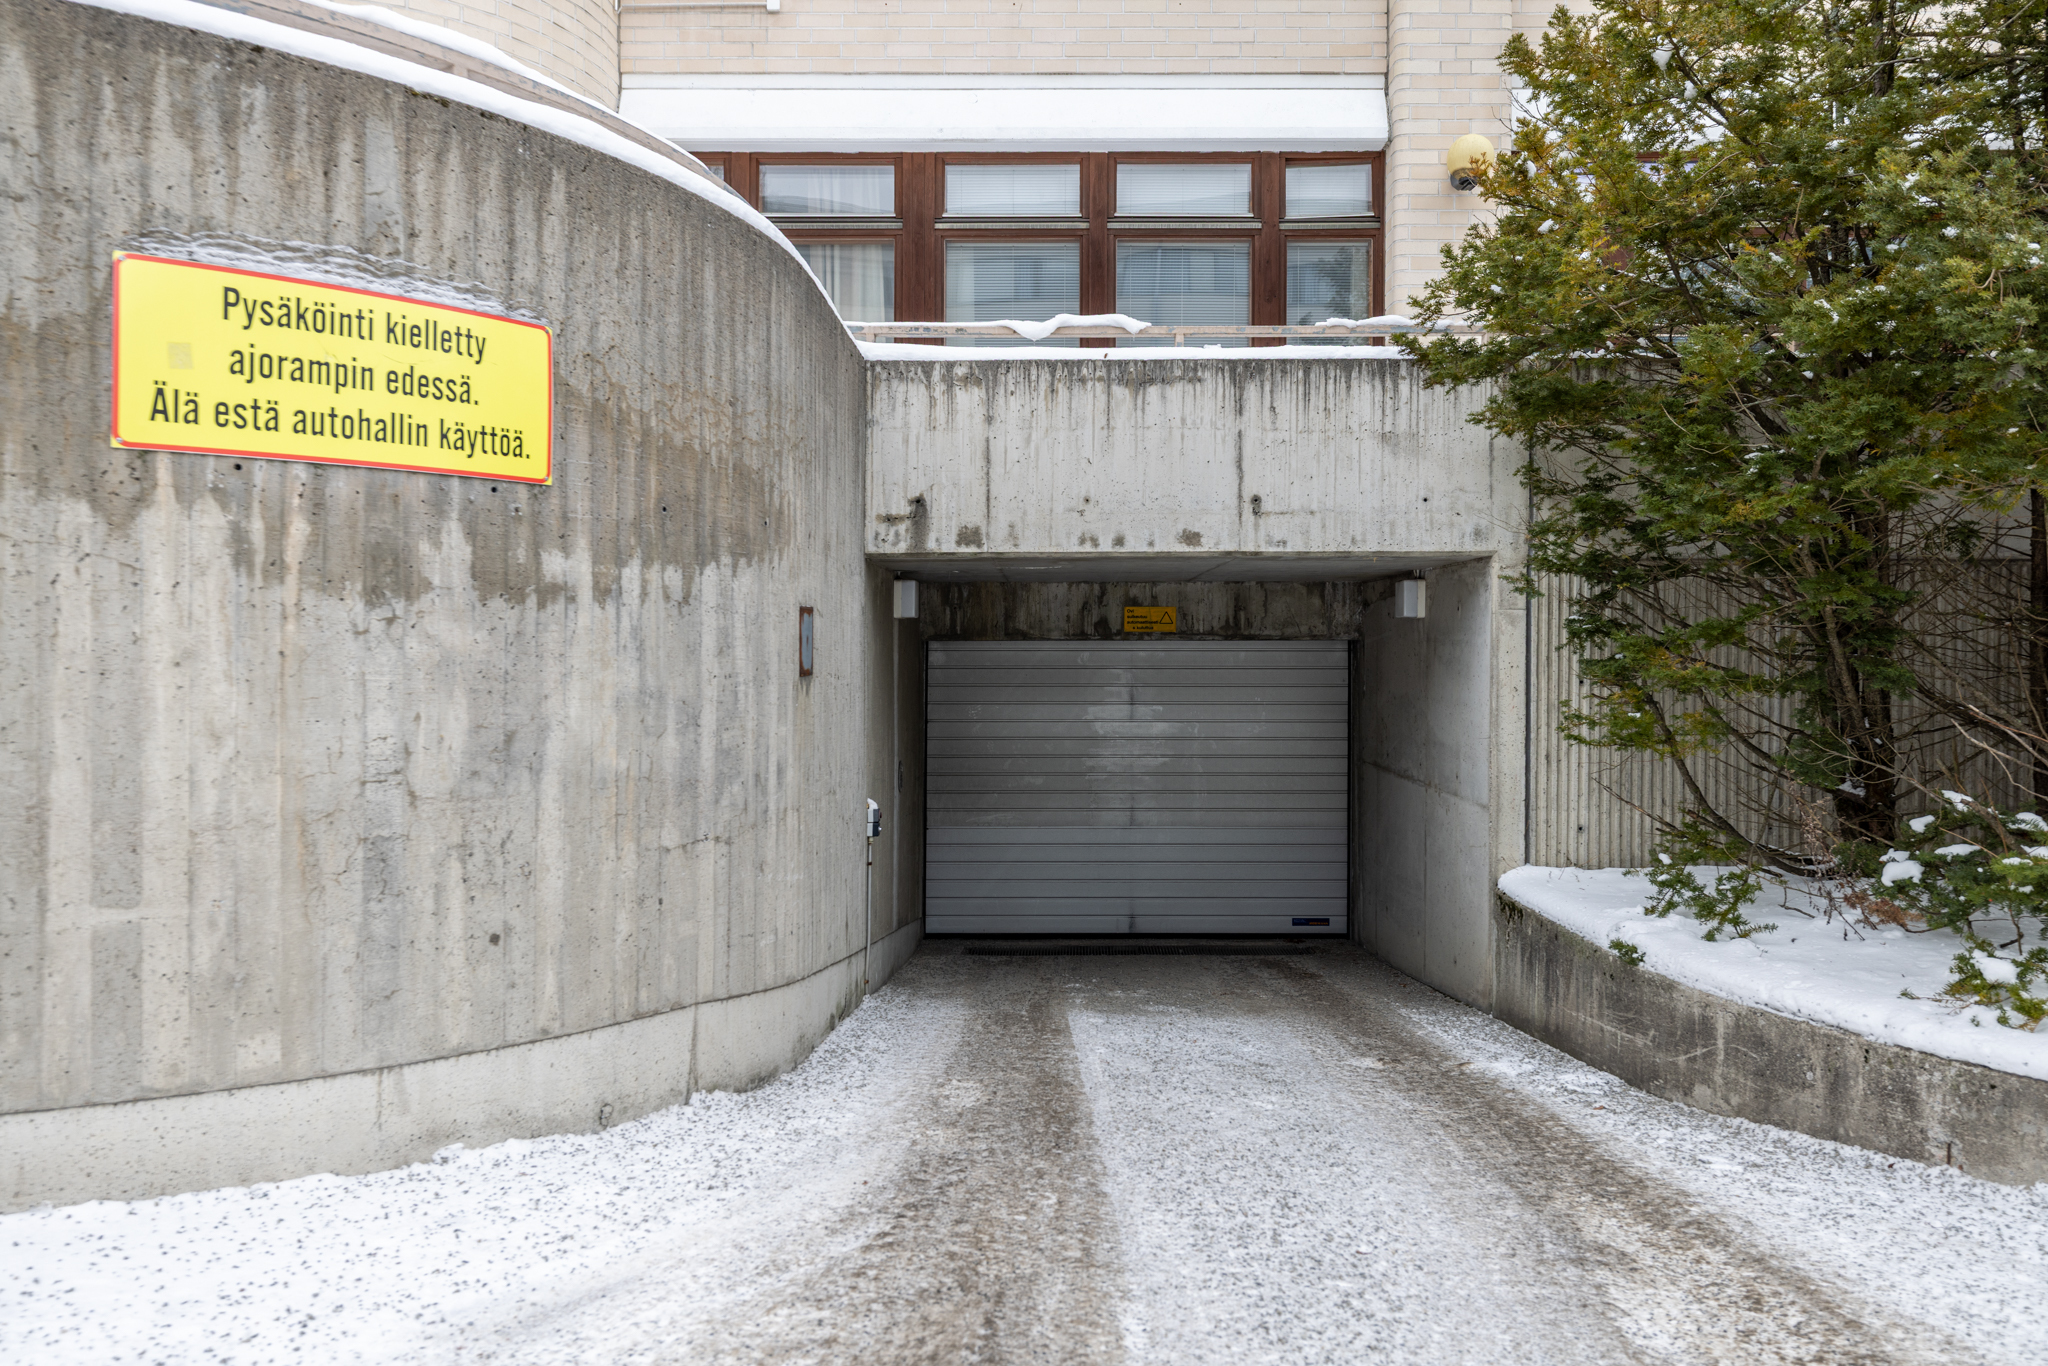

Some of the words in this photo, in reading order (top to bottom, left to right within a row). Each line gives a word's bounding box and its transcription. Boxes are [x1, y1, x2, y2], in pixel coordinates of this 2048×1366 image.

[222, 286, 374, 341] Pysäköinti
[385, 312, 487, 364] kielletty
[229, 343, 374, 394] ajorampin
[386, 365, 480, 405] edessä.
[150, 380, 200, 425] Älä
[214, 399, 280, 432] estä
[293, 407, 428, 447] autohallin
[438, 418, 531, 459] käyttöä.
